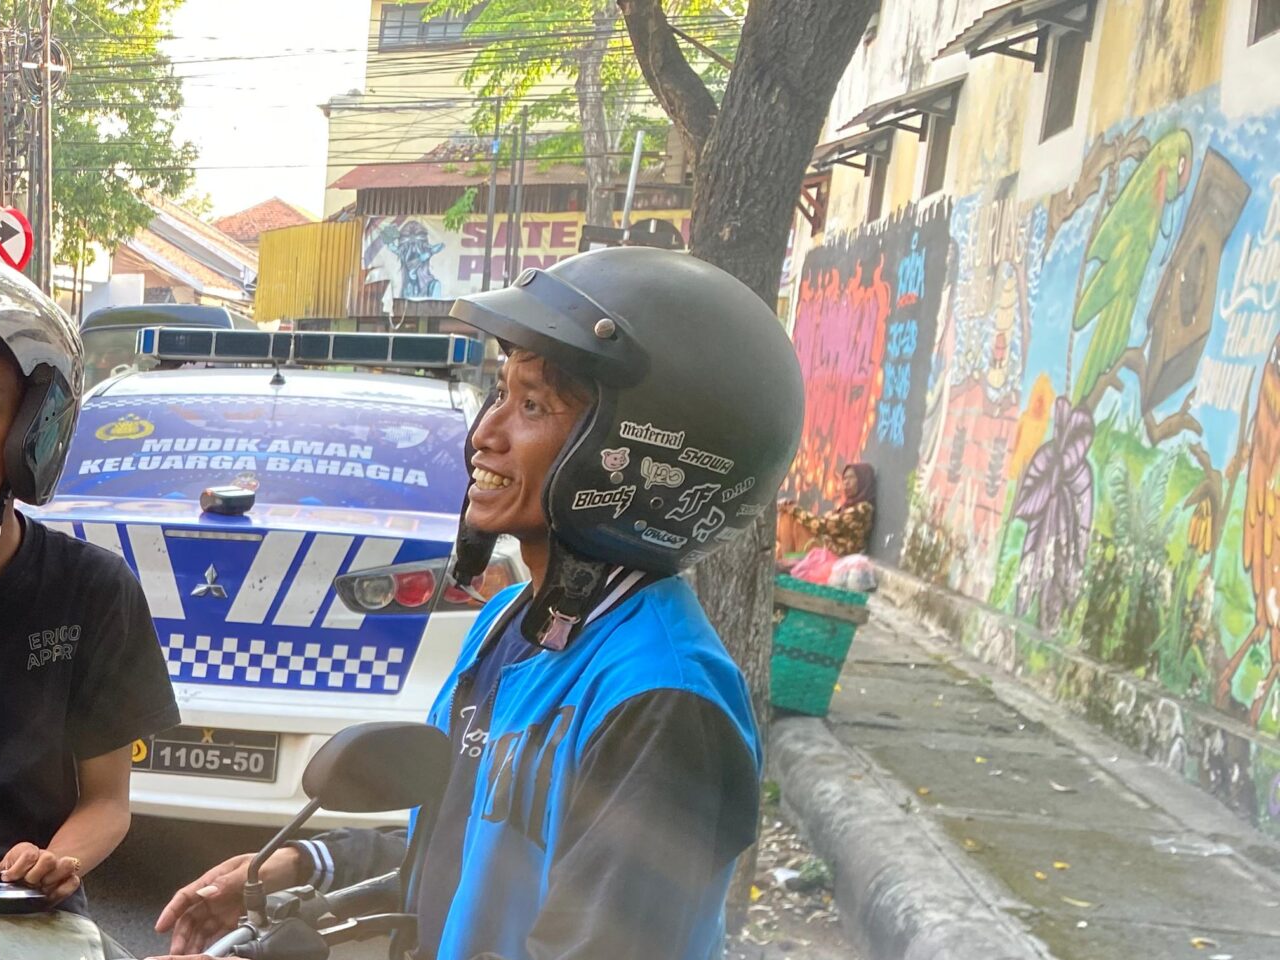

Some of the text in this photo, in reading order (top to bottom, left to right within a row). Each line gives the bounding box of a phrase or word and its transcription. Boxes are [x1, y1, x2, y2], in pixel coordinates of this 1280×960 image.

[461, 221, 578, 249] SATE
[141, 438, 374, 460] MUDIK AMAN
[621, 422, 685, 449] maternal
[79, 455, 429, 487] KELUARGA BAHAGIA
[679, 448, 734, 474] SHOWA
[201, 728, 214, 744] X
[160, 746, 265, 773] 1105-50
